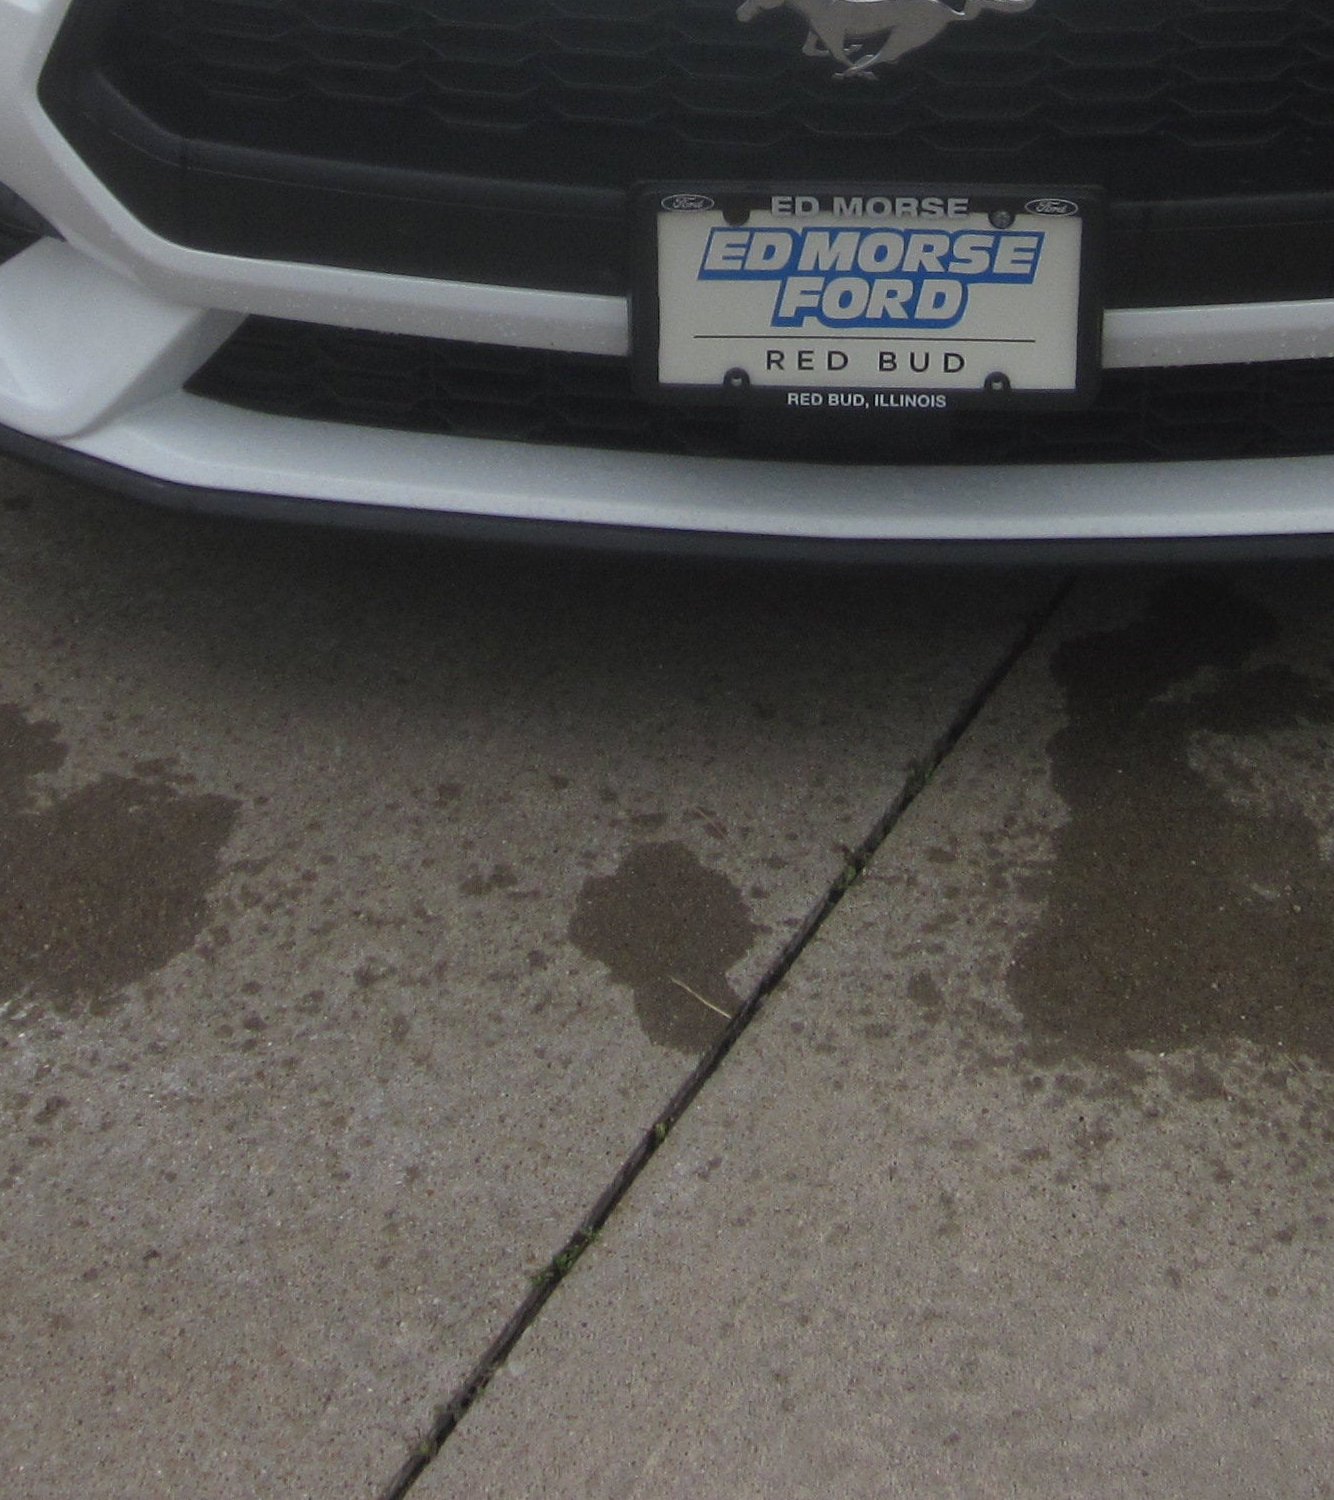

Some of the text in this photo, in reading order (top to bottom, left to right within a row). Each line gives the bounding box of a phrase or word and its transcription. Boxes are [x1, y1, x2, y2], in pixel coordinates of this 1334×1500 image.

[672, 197, 704, 209] Ford
[771, 196, 969, 219] ED MORSE
[1035, 201, 1068, 213] Ford
[777, 276, 963, 320] FORD
[767, 350, 965, 373] RED BUD
[787, 393, 947, 408] RED BUD, ILLINOIS
